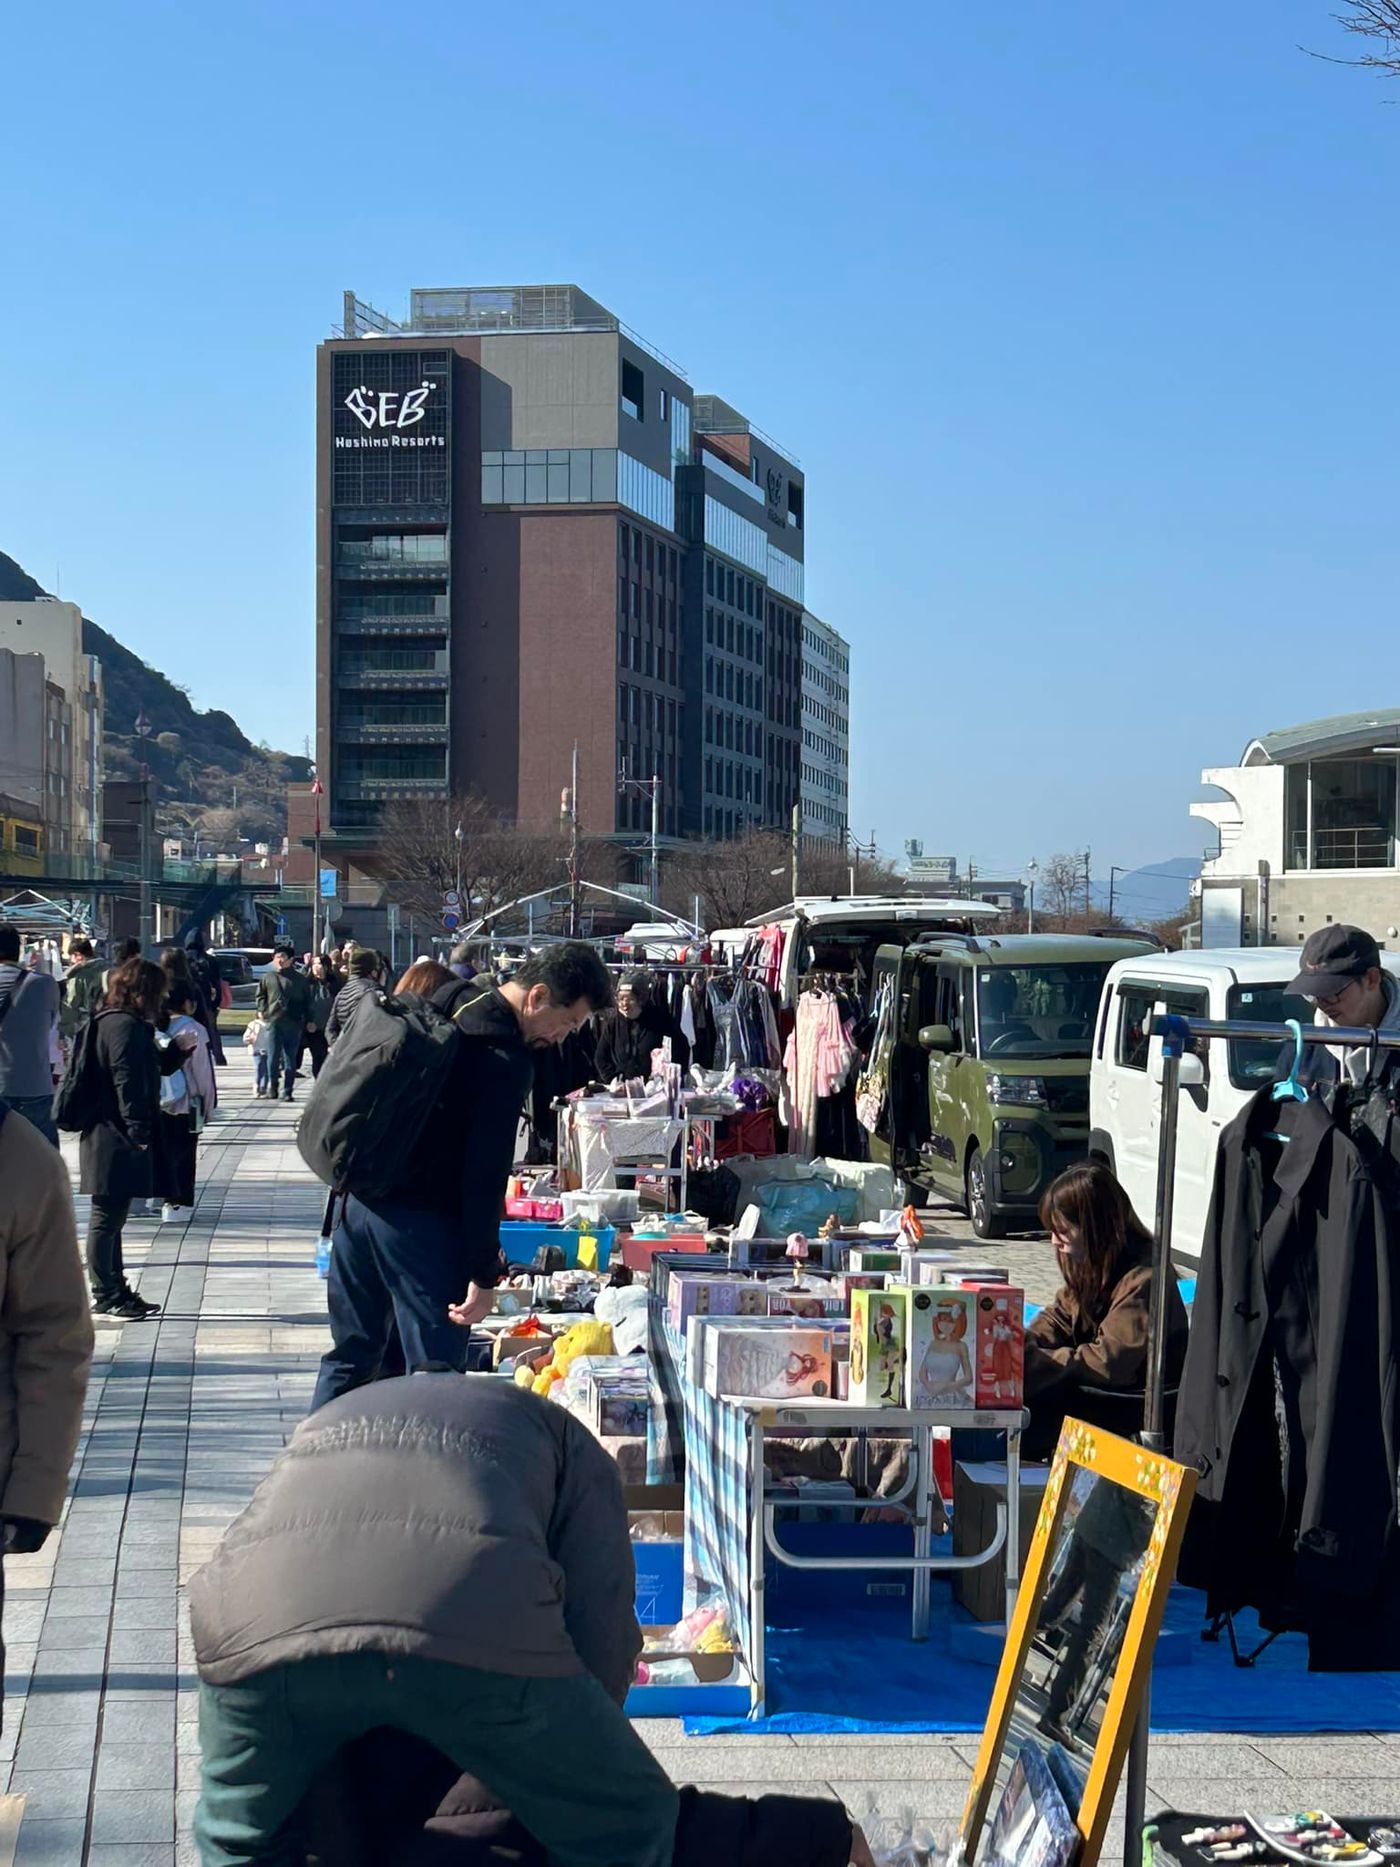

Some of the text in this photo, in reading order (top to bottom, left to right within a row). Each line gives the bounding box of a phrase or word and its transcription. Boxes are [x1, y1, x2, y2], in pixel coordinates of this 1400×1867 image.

[344, 381, 437, 429] BEB
[335, 435, 445, 448] Hoshino Resorts
